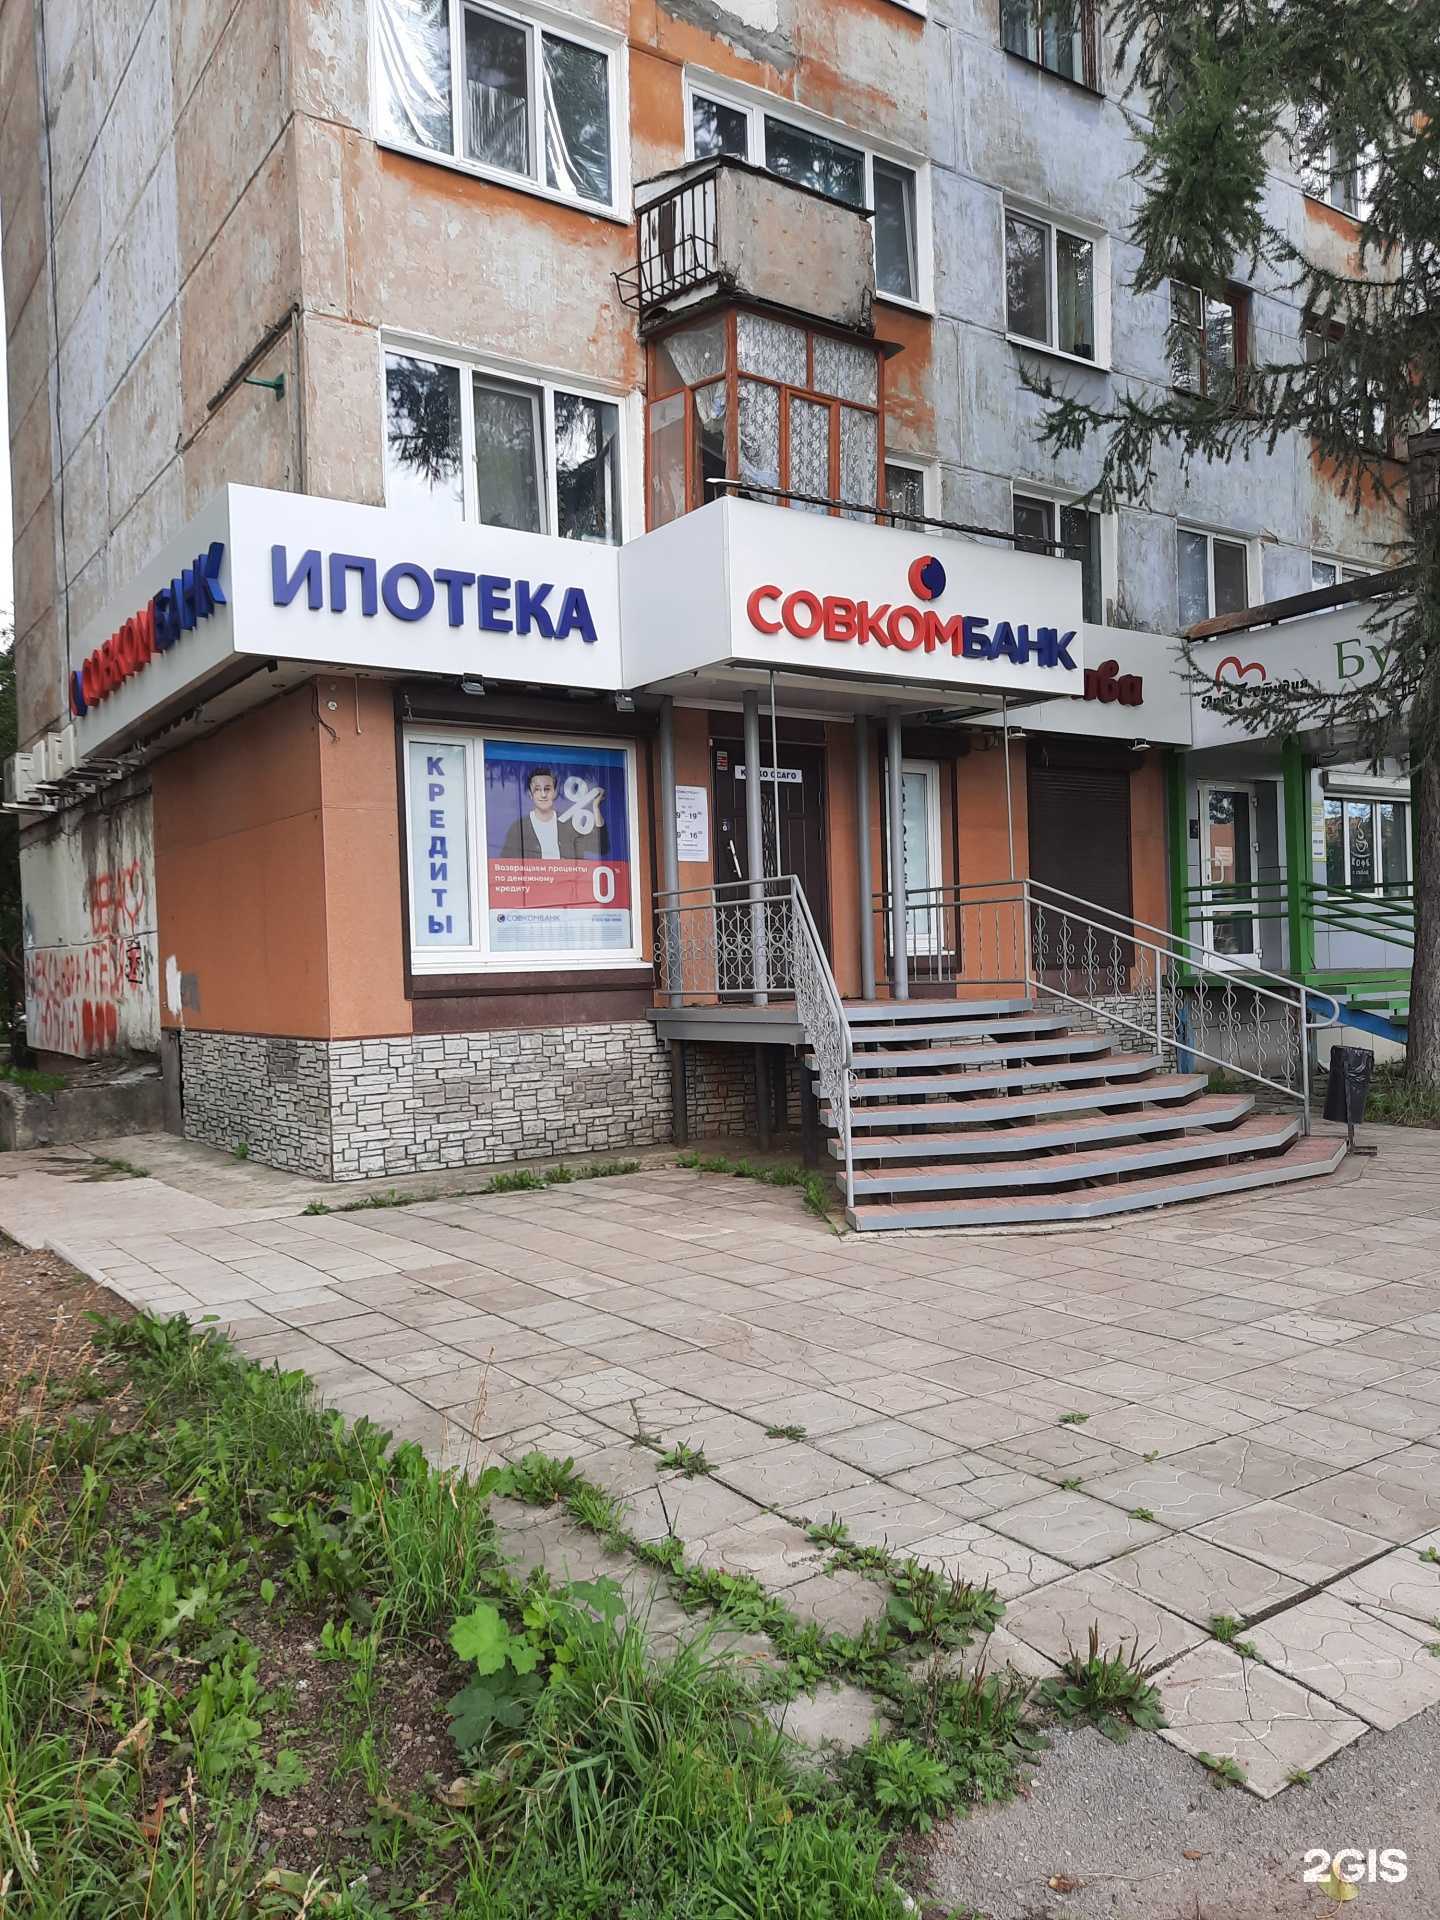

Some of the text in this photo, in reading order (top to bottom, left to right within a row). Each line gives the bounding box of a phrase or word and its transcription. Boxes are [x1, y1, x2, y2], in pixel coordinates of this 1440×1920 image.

[271, 544, 598, 642] ИПОТЕКА
[747, 584, 1078, 671] СОВКОМБАНК
[426, 756, 453, 934] КРЕДИТЫ
[495, 863, 588, 874] Возвращаем проценты
[495, 885, 531, 893] кредиту
[507, 875, 554, 884] денежному
